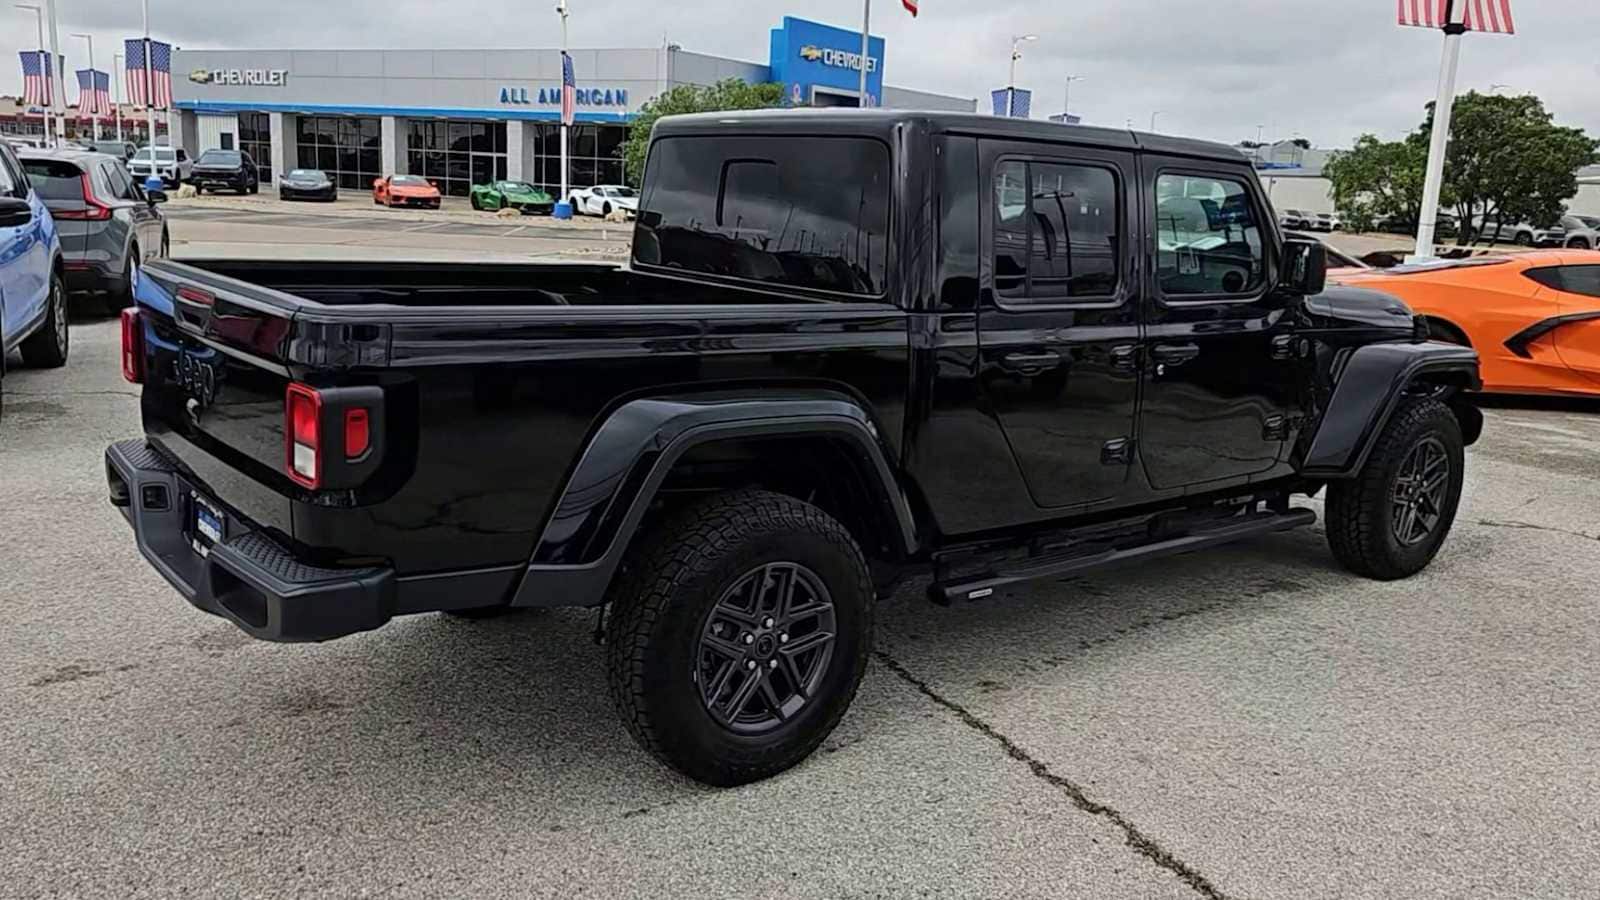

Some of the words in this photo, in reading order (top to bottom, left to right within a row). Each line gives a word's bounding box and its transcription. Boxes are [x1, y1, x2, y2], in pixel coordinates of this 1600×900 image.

[823, 48, 877, 73] CHEVROET
[213, 69, 287, 86] CHEVROLET
[500, 88, 530, 105] ALL
[538, 88, 628, 106] AMRICAN
